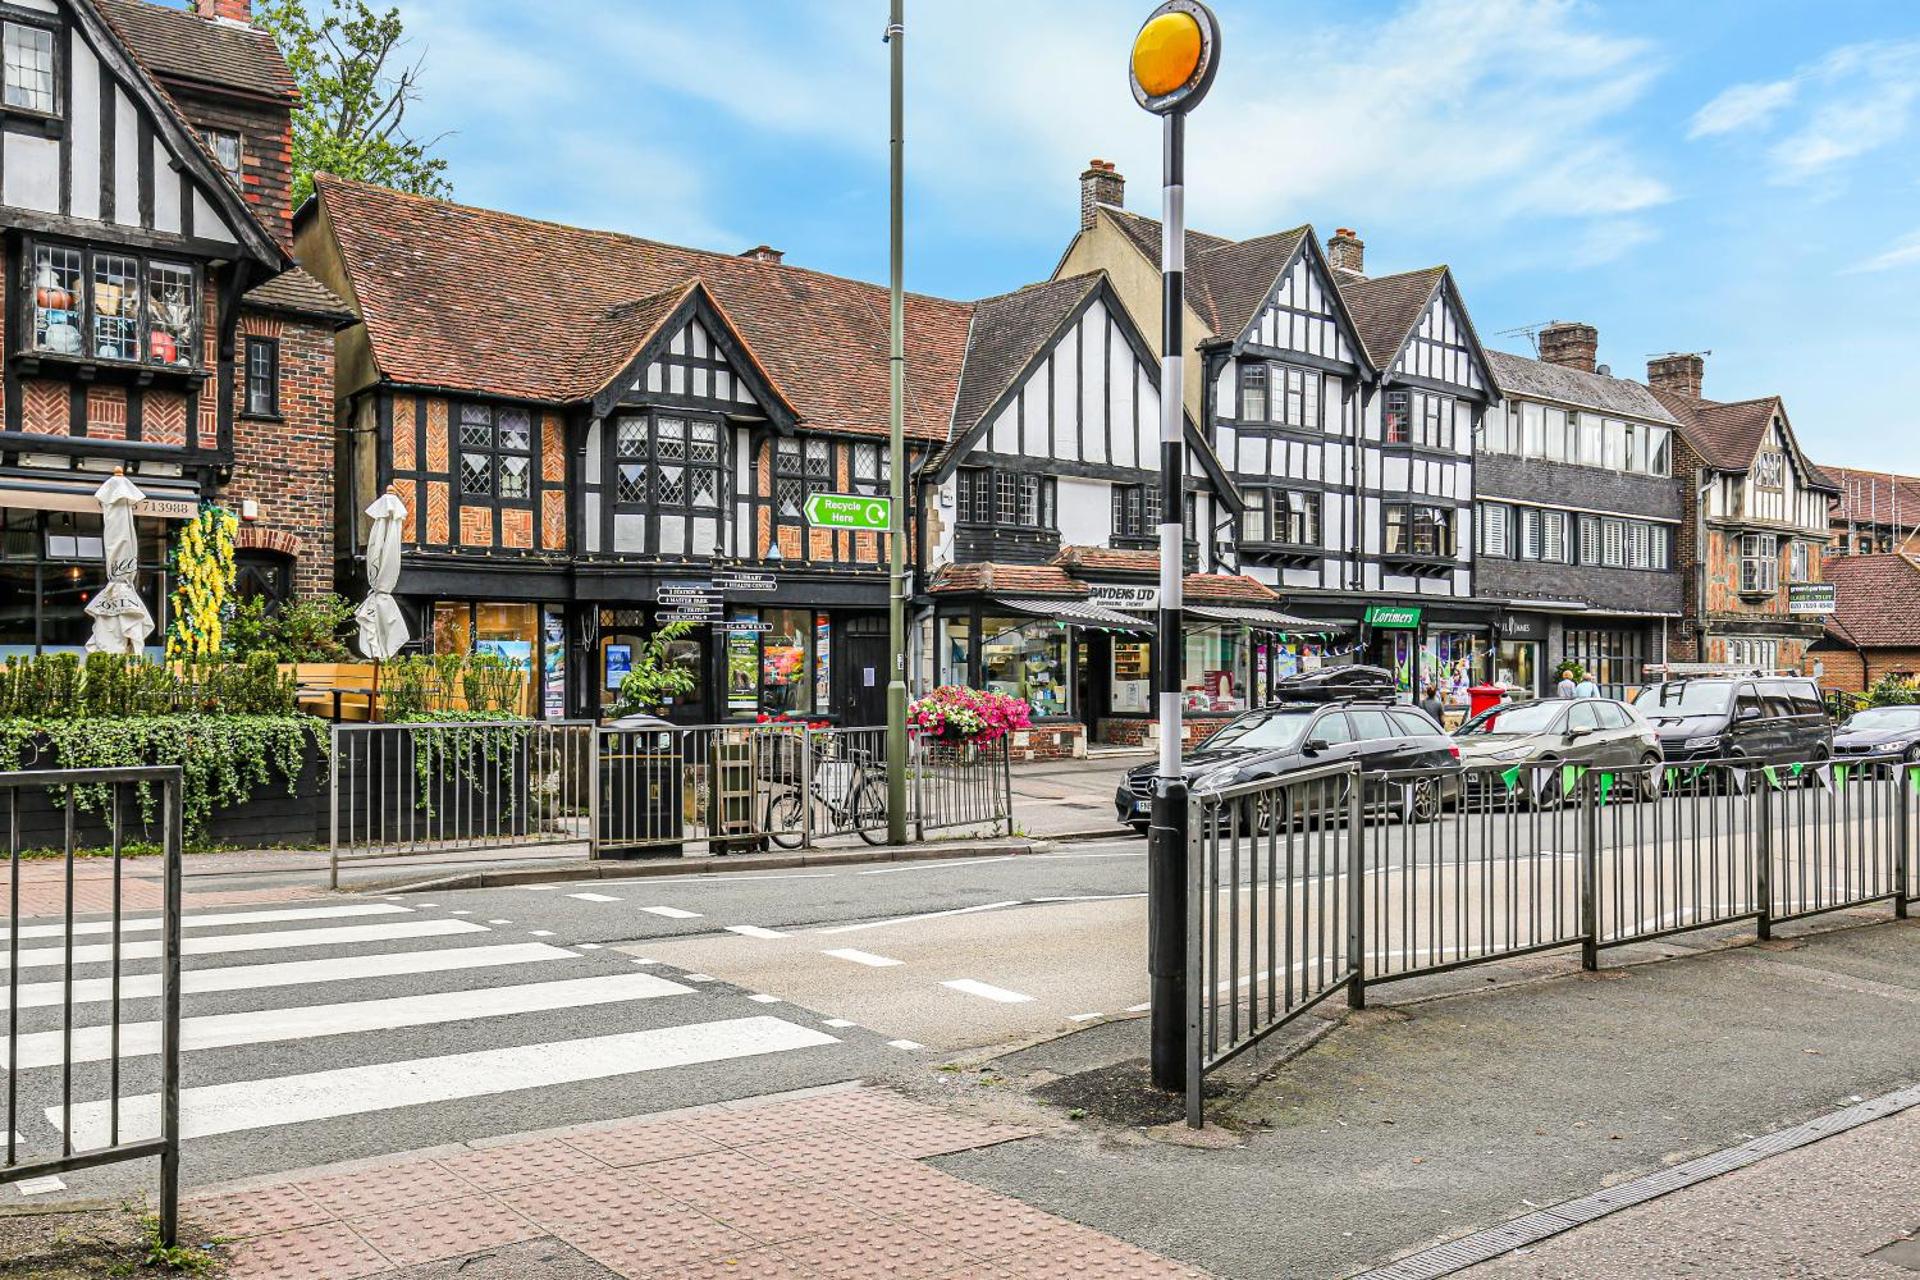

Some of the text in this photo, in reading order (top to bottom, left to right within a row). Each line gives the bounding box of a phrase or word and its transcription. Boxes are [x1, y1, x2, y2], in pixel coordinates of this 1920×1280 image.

[143, 501, 188, 514] 713988
[825, 500, 861, 512] Recycle
[832, 513, 854, 523] Here
[1137, 589, 1154, 600] LTD
[1372, 608, 1414, 623] Lorimers
